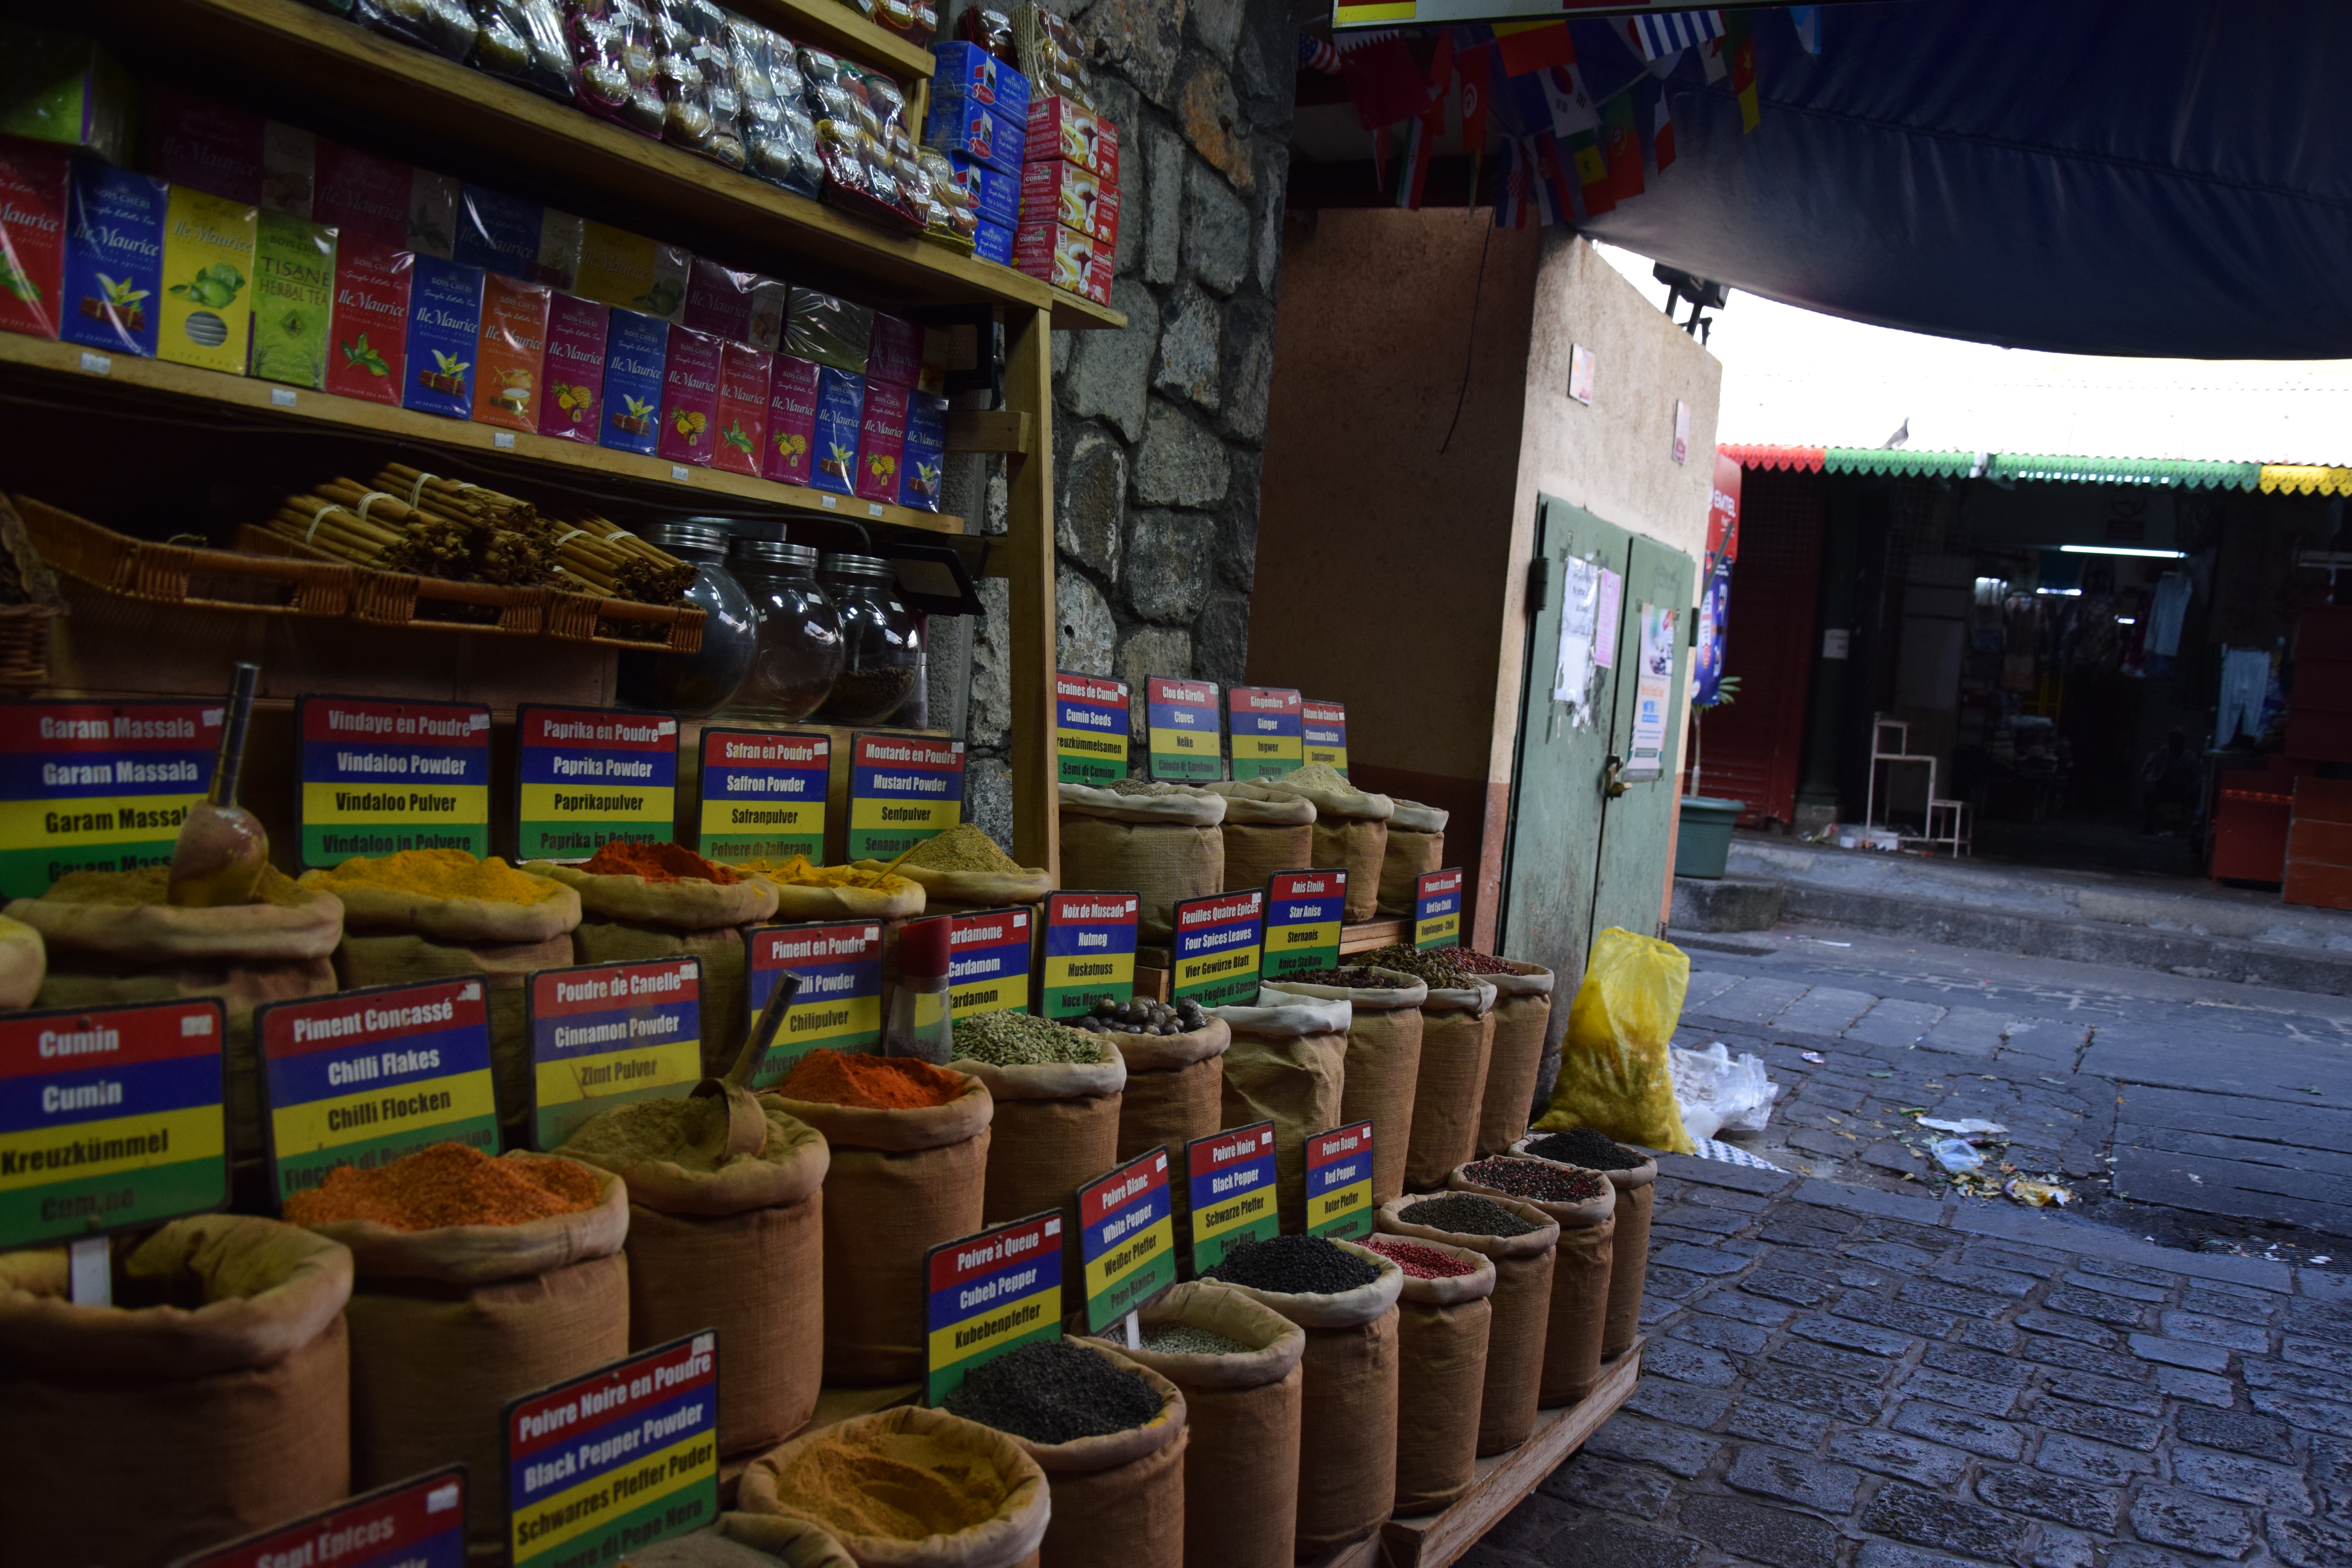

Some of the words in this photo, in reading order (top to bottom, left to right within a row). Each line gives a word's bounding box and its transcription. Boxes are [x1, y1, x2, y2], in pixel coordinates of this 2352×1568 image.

[972, 83, 980, 99] 3
[1100, 194, 1117, 205] CORSON
[1060, 234, 1065, 242] 25
[1094, 255, 1111, 266] CORSON
[261, 256, 331, 287] TISANE
[260, 279, 305, 301] HERBAL
[308, 290, 327, 306] TEA
[431, 277, 449, 289] BOIS
[450, 283, 472, 294] CHERI
[339, 289, 353, 305] Ile
[351, 292, 405, 317] Maurice
[417, 307, 431, 322] Ile
[429, 310, 477, 333] Maurice
[556, 325, 575, 335] Single
[563, 313, 577, 323] BOIS
[579, 318, 598, 327] CHERI
[624, 329, 639, 338] BOIS
[640, 334, 658, 343] CHERI
[549, 341, 561, 355] Ile
[559, 344, 602, 365] Maurice
[612, 357, 623, 370] Ile
[621, 359, 661, 379] Maurice
[783, 371, 795, 380] BOIS
[796, 375, 811, 383] CHERI
[669, 371, 680, 383] Ile
[678, 373, 716, 392] Maurice
[722, 384, 732, 396] Ile
[729, 387, 765, 405] Maurice
[865, 420, 875, 430] Ile
[873, 421, 903, 438] Maurice
[908, 431, 916, 441] Ile
[915, 432, 943, 448] Maurice
[1057, 681, 1085, 697] Graines
[1087, 685, 1095, 698] de
[1096, 686, 1118, 702] Cumin
[1162, 686, 1176, 699] Clou
[1177, 688, 1184, 700] de
[1185, 688, 1205, 702] Girofle
[1250, 695, 1283, 709] Gingembre
[328, 710, 393, 734] Vindaye
[397, 719, 414, 733] en
[419, 716, 470, 737] Poudre
[1066, 708, 1089, 724] Cumin
[1090, 711, 1111, 727] Seeds
[1174, 711, 1194, 724] Cloves
[1258, 717, 1278, 731] Ginger
[1303, 708, 1317, 719] Bâtons
[1318, 710, 1323, 719] de
[1323, 710, 1338, 721] Canelle
[40, 716, 109, 739] Garam
[114, 717, 196, 739] Massala
[544, 720, 594, 739] Paprika
[597, 726, 612, 740] en
[615, 724, 659, 742] Poudre
[1305, 730, 1326, 741] Cinnamon
[1326, 731, 1339, 742] Sticks
[726, 742, 761, 759] Safran
[763, 746, 776, 760] en
[777, 744, 813, 761] Poudre
[1057, 736, 1121, 755] reuzkümmelsamen
[1177, 736, 1193, 748] Nelke
[1258, 741, 1278, 753] Ingwer
[337, 751, 407, 773] Vindaloo
[411, 755, 466, 775] Powder
[866, 743, 910, 761] Moutarde
[912, 749, 924, 762] en
[925, 747, 956, 765] Poudre
[553, 757, 603, 776] Paprika
[606, 759, 652, 778] Powder
[727, 775, 765, 792] Saffron
[767, 776, 805, 793] Powder
[873, 774, 911, 790] Mustard
[913, 776, 946, 792] Powder
[555, 793, 643, 812] Paprikapulver
[732, 808, 798, 826] Safranpulver
[882, 807, 931, 822] Senfpulver
[1292, 880, 1306, 893] Anis
[1307, 879, 1324, 893] Etoilé
[1425, 881, 1440, 893] Piments
[1440, 880, 1455, 890] Oiseaux
[1062, 903, 1079, 919] Noix
[1080, 905, 1090, 919] de
[1093, 903, 1124, 919] Muscade
[1182, 907, 1211, 925] Feuilles
[1213, 904, 1236, 920] Quatre
[1237, 901, 1258, 916] Epices
[1289, 906, 1303, 918] Star
[1304, 905, 1321, 918] Anise
[1426, 902, 1435, 913] Bird
[1442, 899, 1451, 910] Chilli
[1078, 932, 1107, 947] Nutmeg
[1185, 935, 1200, 950] Four
[1200, 931, 1225, 948] Spices
[1227, 927, 1251, 942] Leaves
[1287, 929, 1318, 943] Sternanis
[772, 939, 811, 960] Piment
[812, 941, 826, 956] en
[829, 936, 865, 955] Poudre
[949, 958, 1000, 977] Cardamom
[1068, 962, 1113, 977] Muskatnuss
[557, 979, 607, 1003] Poudre
[611, 978, 627, 996] de
[630, 973, 681, 993] Canelle
[293, 1013, 361, 1043] Piment
[365, 998, 453, 1032] Concassé
[555, 1020, 626, 1048] Cinnamon
[630, 1014, 679, 1037] Powder
[790, 1009, 849, 1033] Chilipulver
[38, 1025, 119, 1058] Cumin
[328, 1055, 379, 1086] Chilli
[382, 1049, 439, 1076] Flakes
[42, 1080, 123, 1113] Cumin
[1, 1129, 169, 1174] Kreuzkümmel
[1213, 1145, 1236, 1163] Poivre
[1237, 1140, 1255, 1156] Noire
[1323, 1141, 1340, 1157] Poivre
[1341, 1136, 1358, 1152] Rouge
[1212, 1174, 1233, 1194] Black
[1234, 1169, 1259, 1189] Pepper
[1325, 1172, 1336, 1185] Red
[1337, 1164, 1356, 1181] Pepper
[1103, 1183, 1126, 1210] Poivre
[1126, 1174, 1148, 1198] Blanc
[1103, 1219, 1125, 1244] White
[1126, 1203, 1152, 1235] Pepper
[957, 1246, 993, 1272] Poivre
[995, 1241, 1002, 1259] à
[1005, 1232, 1039, 1256] Queue
[960, 1277, 996, 1310] Cubeb
[998, 1268, 1036, 1296] Pepper
[955, 1303, 1041, 1350] Kubebenpfeffer
[519, 1401, 578, 1443] Poivre
[581, 1383, 627, 1419] Noire
[630, 1375, 652, 1399] en
[655, 1354, 711, 1390] Poudre
[524, 1453, 577, 1493] Black
[579, 1426, 640, 1471] Pepper
[643, 1403, 704, 1444] Powder
[256, 1540, 314, 1568] Sept
[318, 1516, 395, 1561] Epices
